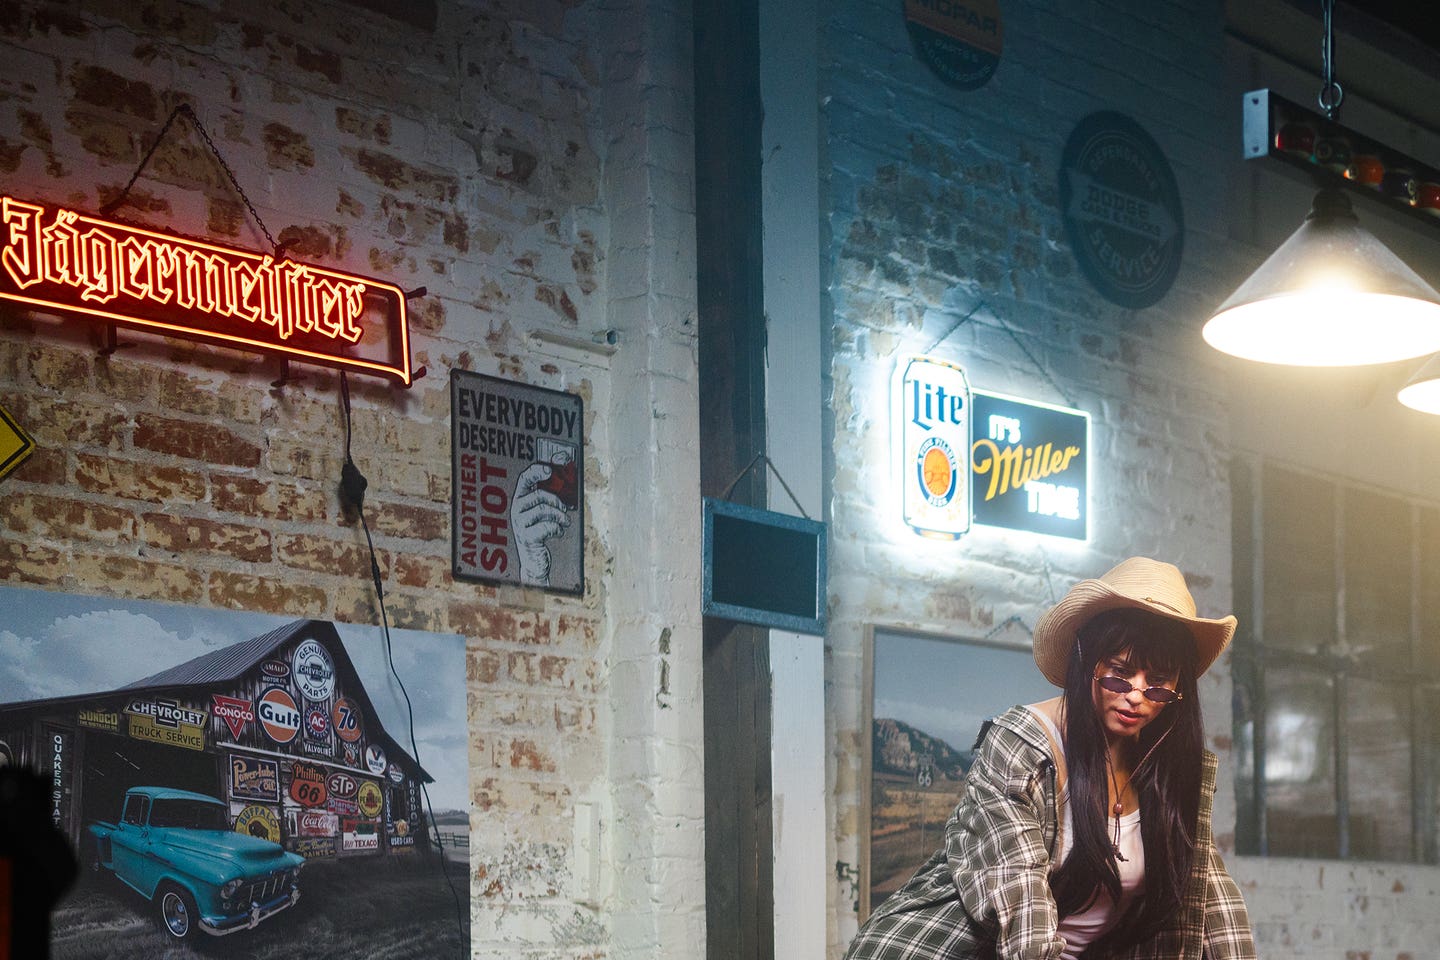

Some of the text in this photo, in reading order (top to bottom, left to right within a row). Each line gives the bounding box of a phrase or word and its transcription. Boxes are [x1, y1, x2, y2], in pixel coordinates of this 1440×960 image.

[1088, 228, 1161, 280] SERVICE
[458, 388, 577, 437] EVERYBODY
[911, 379, 964, 431] Lite
[459, 422, 535, 461] DESERVES
[972, 439, 1080, 501] Miller
[461, 454, 477, 567] ANOTHER
[480, 456, 508, 574] SHOT
[299, 645, 330, 664] GENUINE
[303, 683, 328, 697] PARTS
[79, 711, 119, 726] SUNOCO
[132, 702, 203, 725] CHEVROLET
[214, 705, 254, 721] CONOCO
[259, 703, 300, 728] Gulf
[311, 715, 324, 728] AC
[338, 706, 357, 731] 76
[133, 725, 201, 747] TRUCK SERVICE
[52, 735, 63, 826] QUAKER STAT
[293, 763, 325, 783] Phillips
[331, 775, 354, 794] STP
[918, 771, 932, 786] 66
[299, 783, 320, 803] 66
[238, 805, 278, 829] BUFFALO
[355, 840, 378, 848] TEXACO
